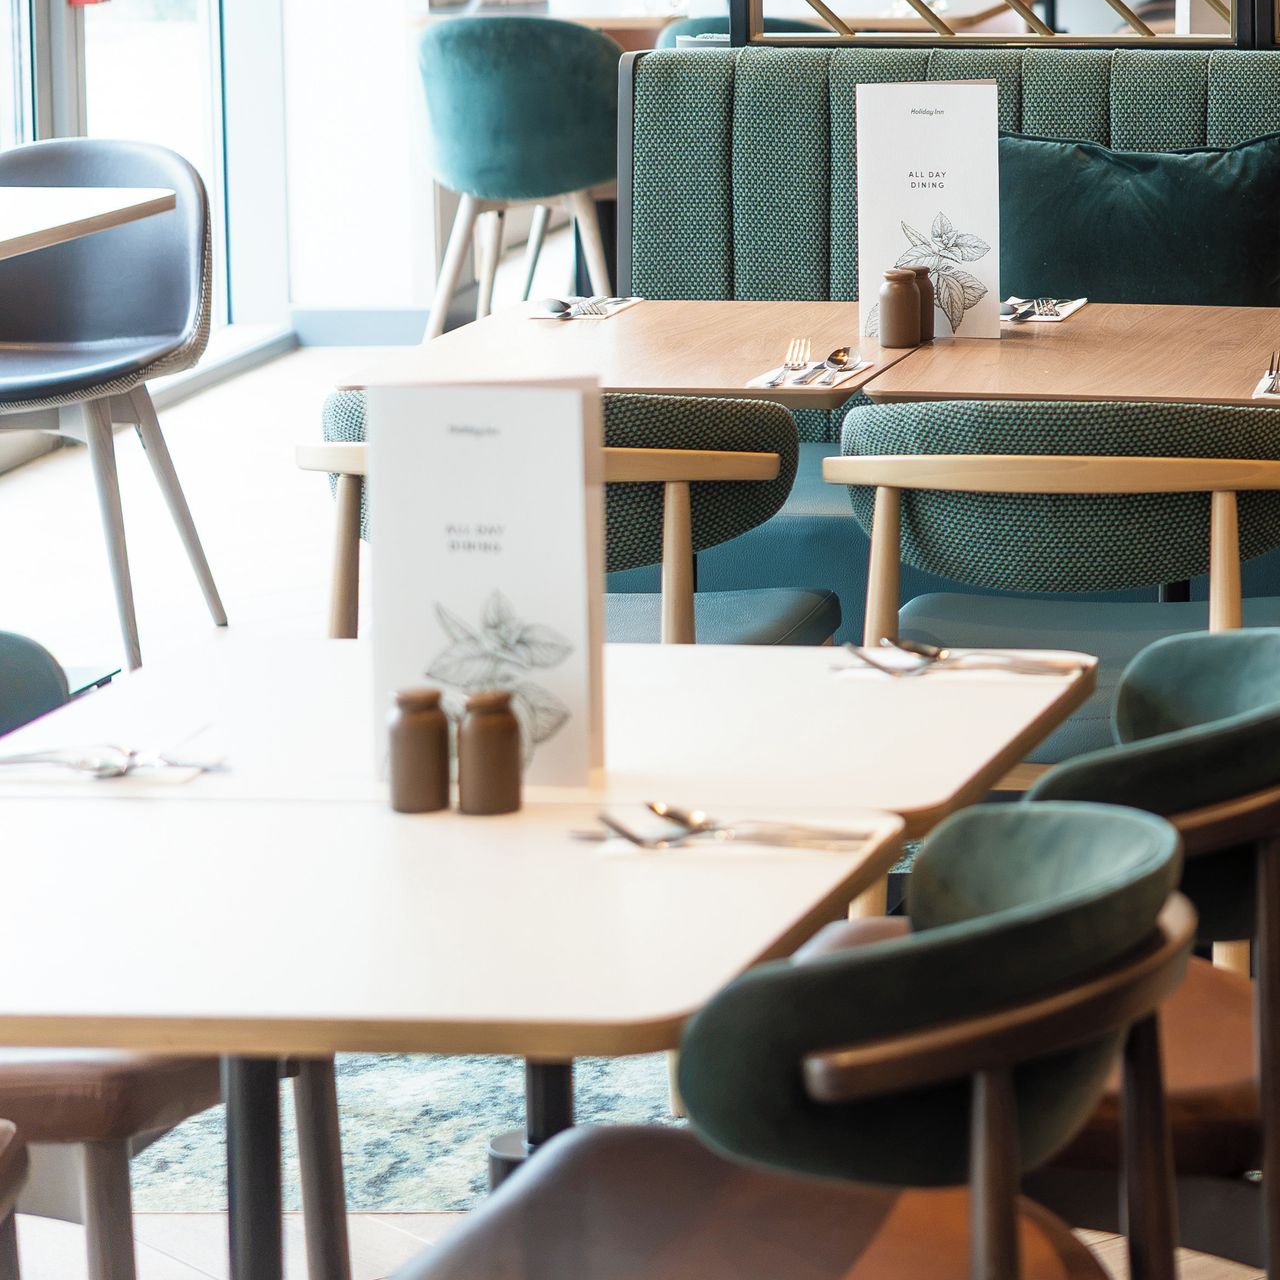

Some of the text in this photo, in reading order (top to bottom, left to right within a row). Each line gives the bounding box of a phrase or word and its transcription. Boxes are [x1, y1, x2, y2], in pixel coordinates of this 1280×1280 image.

[910, 108, 945, 117] Holiday Inn
[908, 171, 947, 179] ALL DAY
[910, 181, 945, 189] DINING
